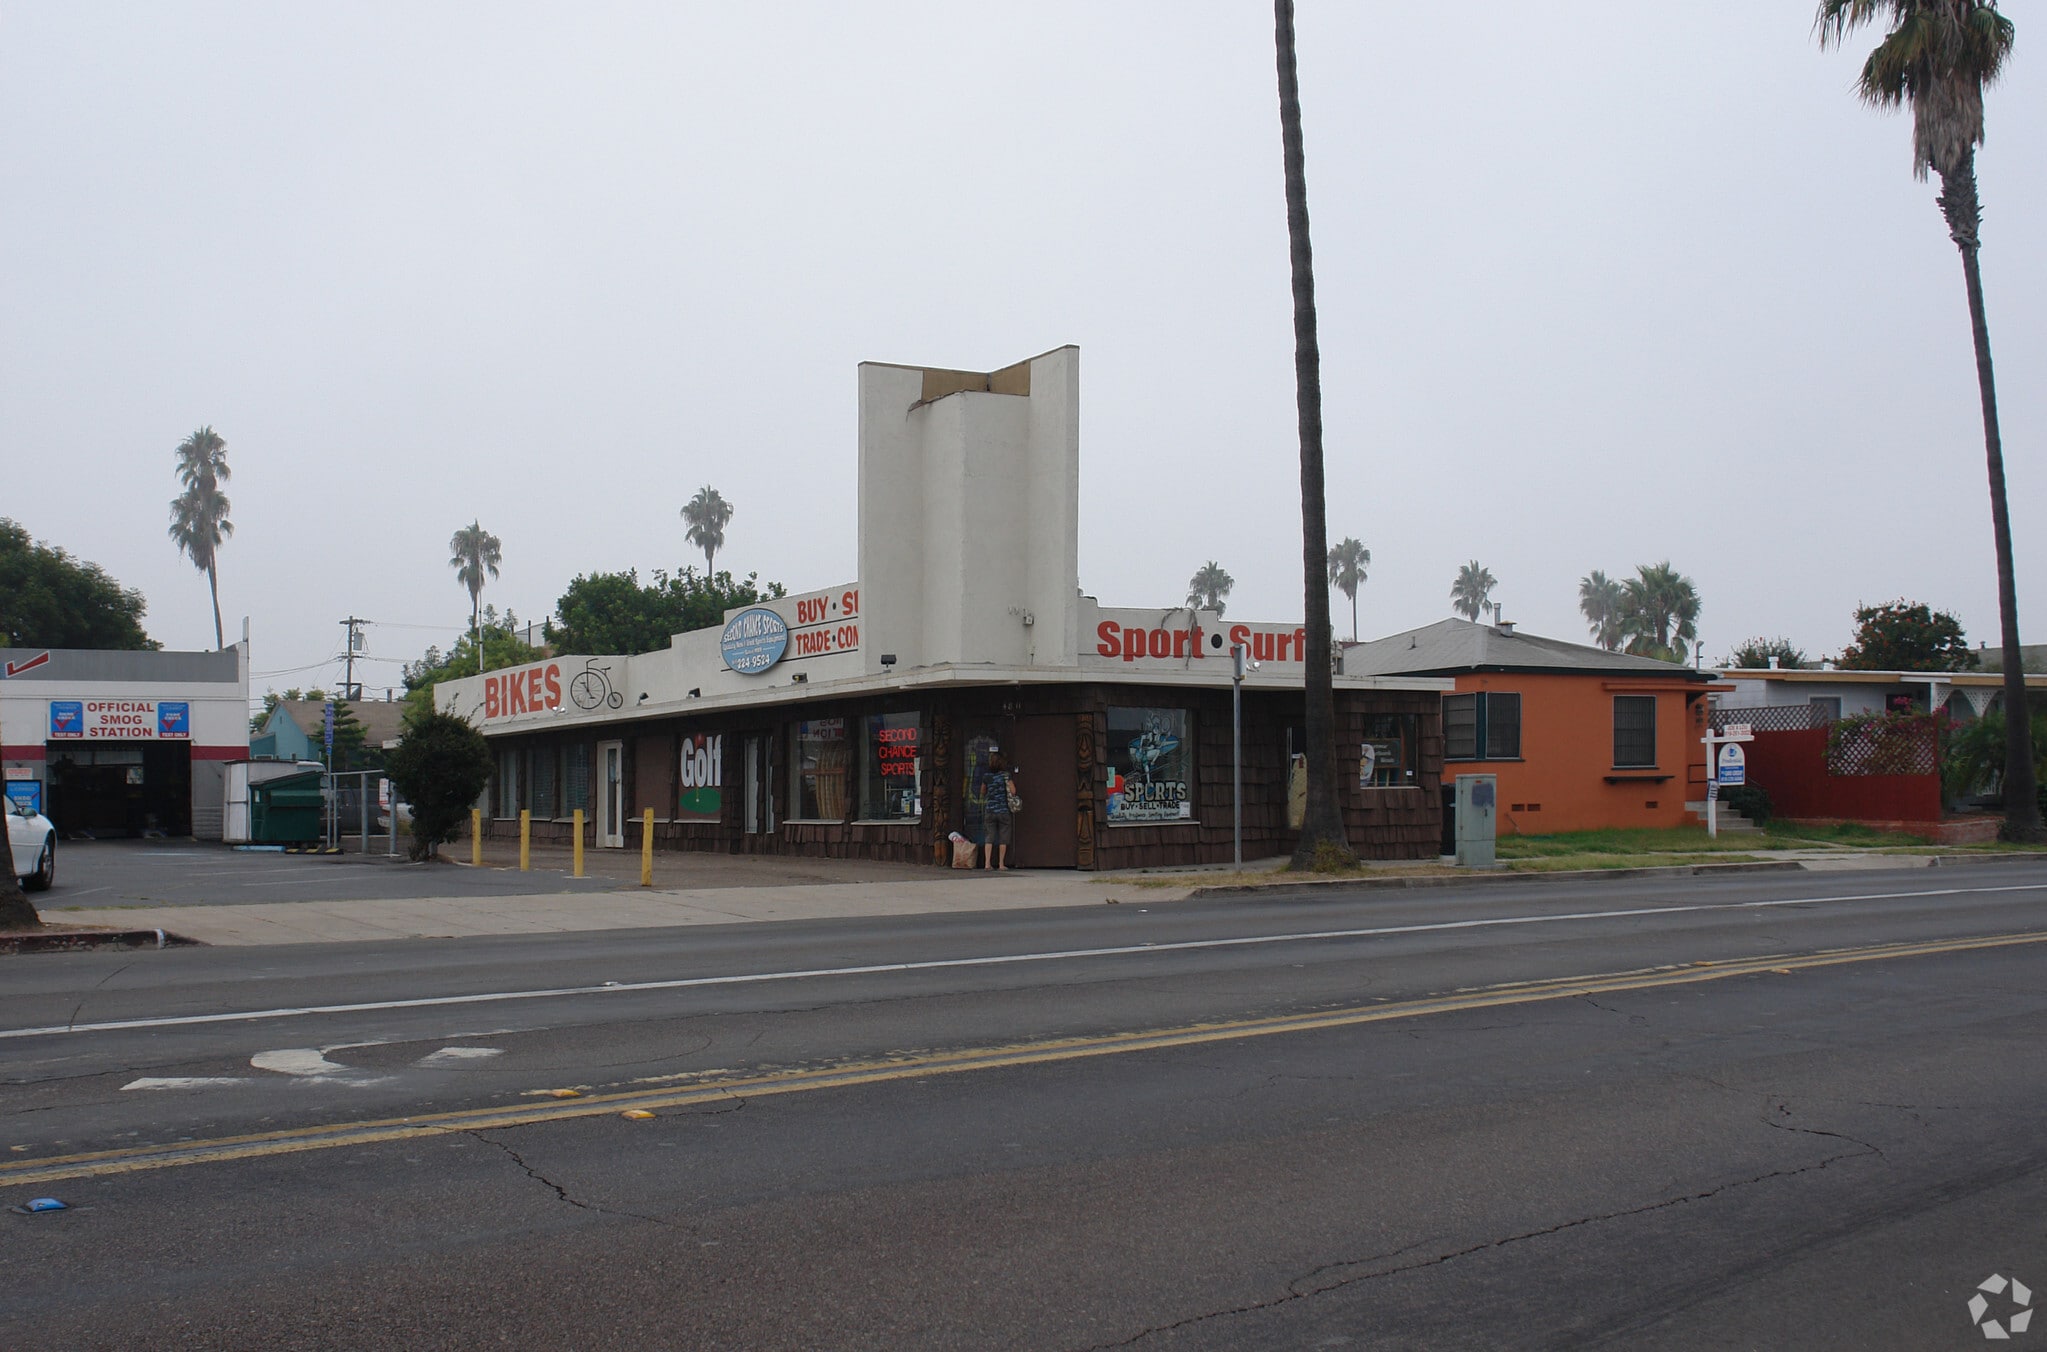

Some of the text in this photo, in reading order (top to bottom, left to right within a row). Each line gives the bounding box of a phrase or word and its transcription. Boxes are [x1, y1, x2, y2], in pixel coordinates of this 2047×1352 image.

[797, 596, 829, 624] BUY
[724, 614, 784, 643] SECOND CHANCE SPORTS
[795, 629, 831, 656] TRADE
[1097, 620, 1204, 662] Sport
[485, 664, 561, 719] BIKES
[87, 702, 155, 712] OFFICIAL
[100, 714, 143, 725] SMOG
[89, 727, 152, 737] STATION
[879, 728, 917, 743] SECOND
[878, 745, 917, 759] CHANCE
[681, 734, 722, 788] Golf
[881, 761, 915, 776] SPORTS
[1124, 782, 1187, 801] SPORTS
[1120, 803, 1135, 811] BUY
[1139, 802, 1156, 810] SELL
[1159, 801, 1180, 810] TRADE
